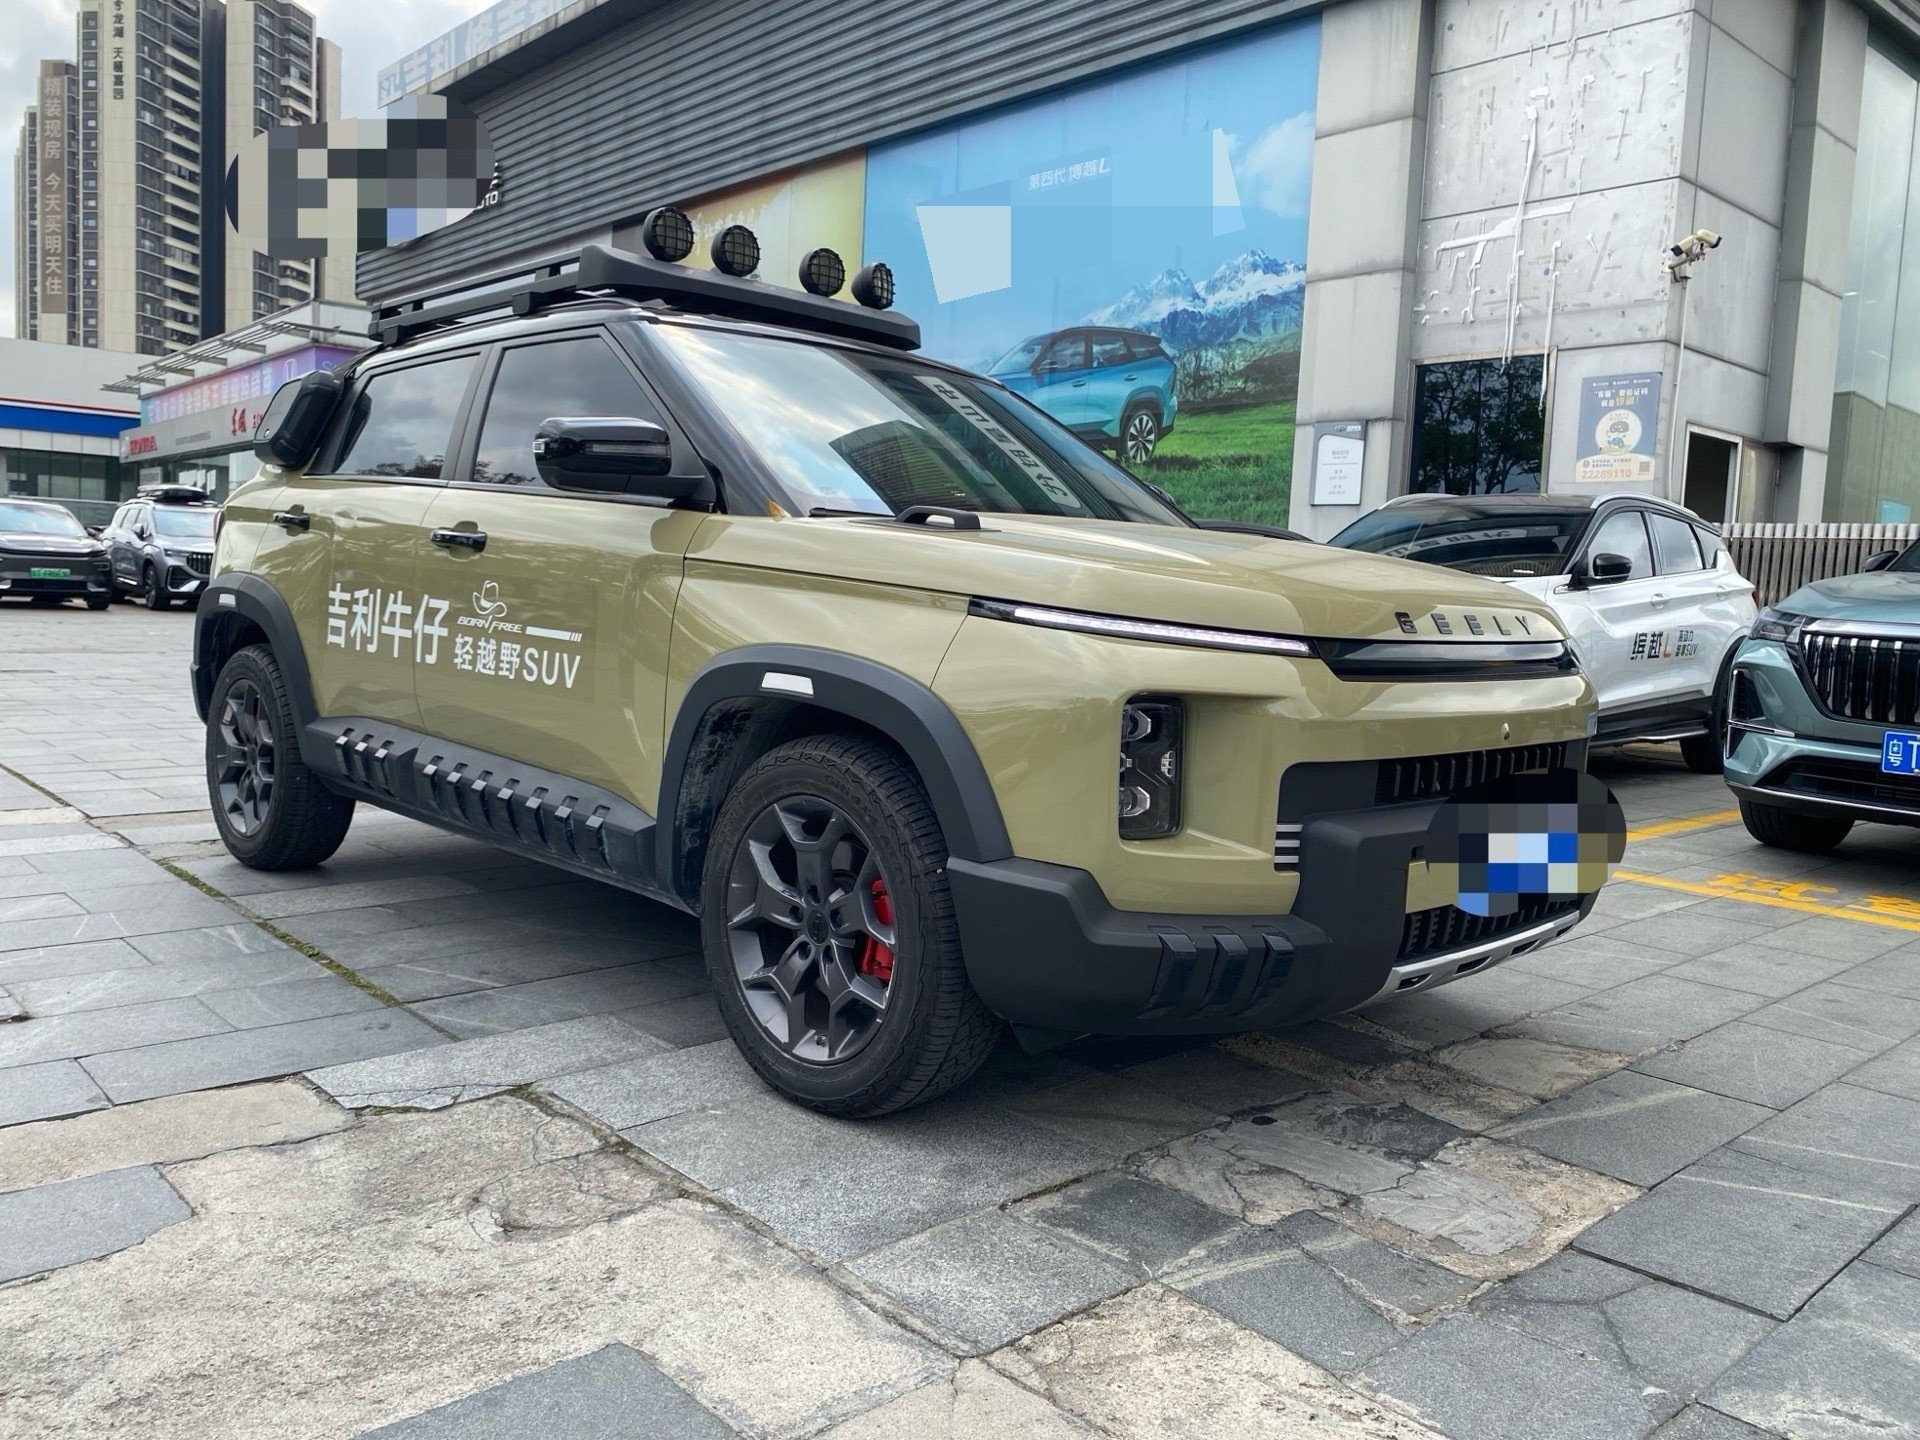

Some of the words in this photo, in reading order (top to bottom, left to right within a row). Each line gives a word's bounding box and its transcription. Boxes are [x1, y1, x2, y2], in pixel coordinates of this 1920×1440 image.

[44, 78, 62, 159] 精装现房
[1028, 167, 1067, 191] 第四代
[1069, 157, 1112, 182] 博越L
[44, 172, 63, 296] 今天买明天住
[326, 583, 450, 664] 吉利牛仔
[457, 615, 493, 629] BORN
[488, 621, 523, 634] FREE
[1394, 611, 1532, 636] GEELY
[453, 633, 581, 689] 轻越野SUV
[1887, 738, 1920, 769] 粤T
